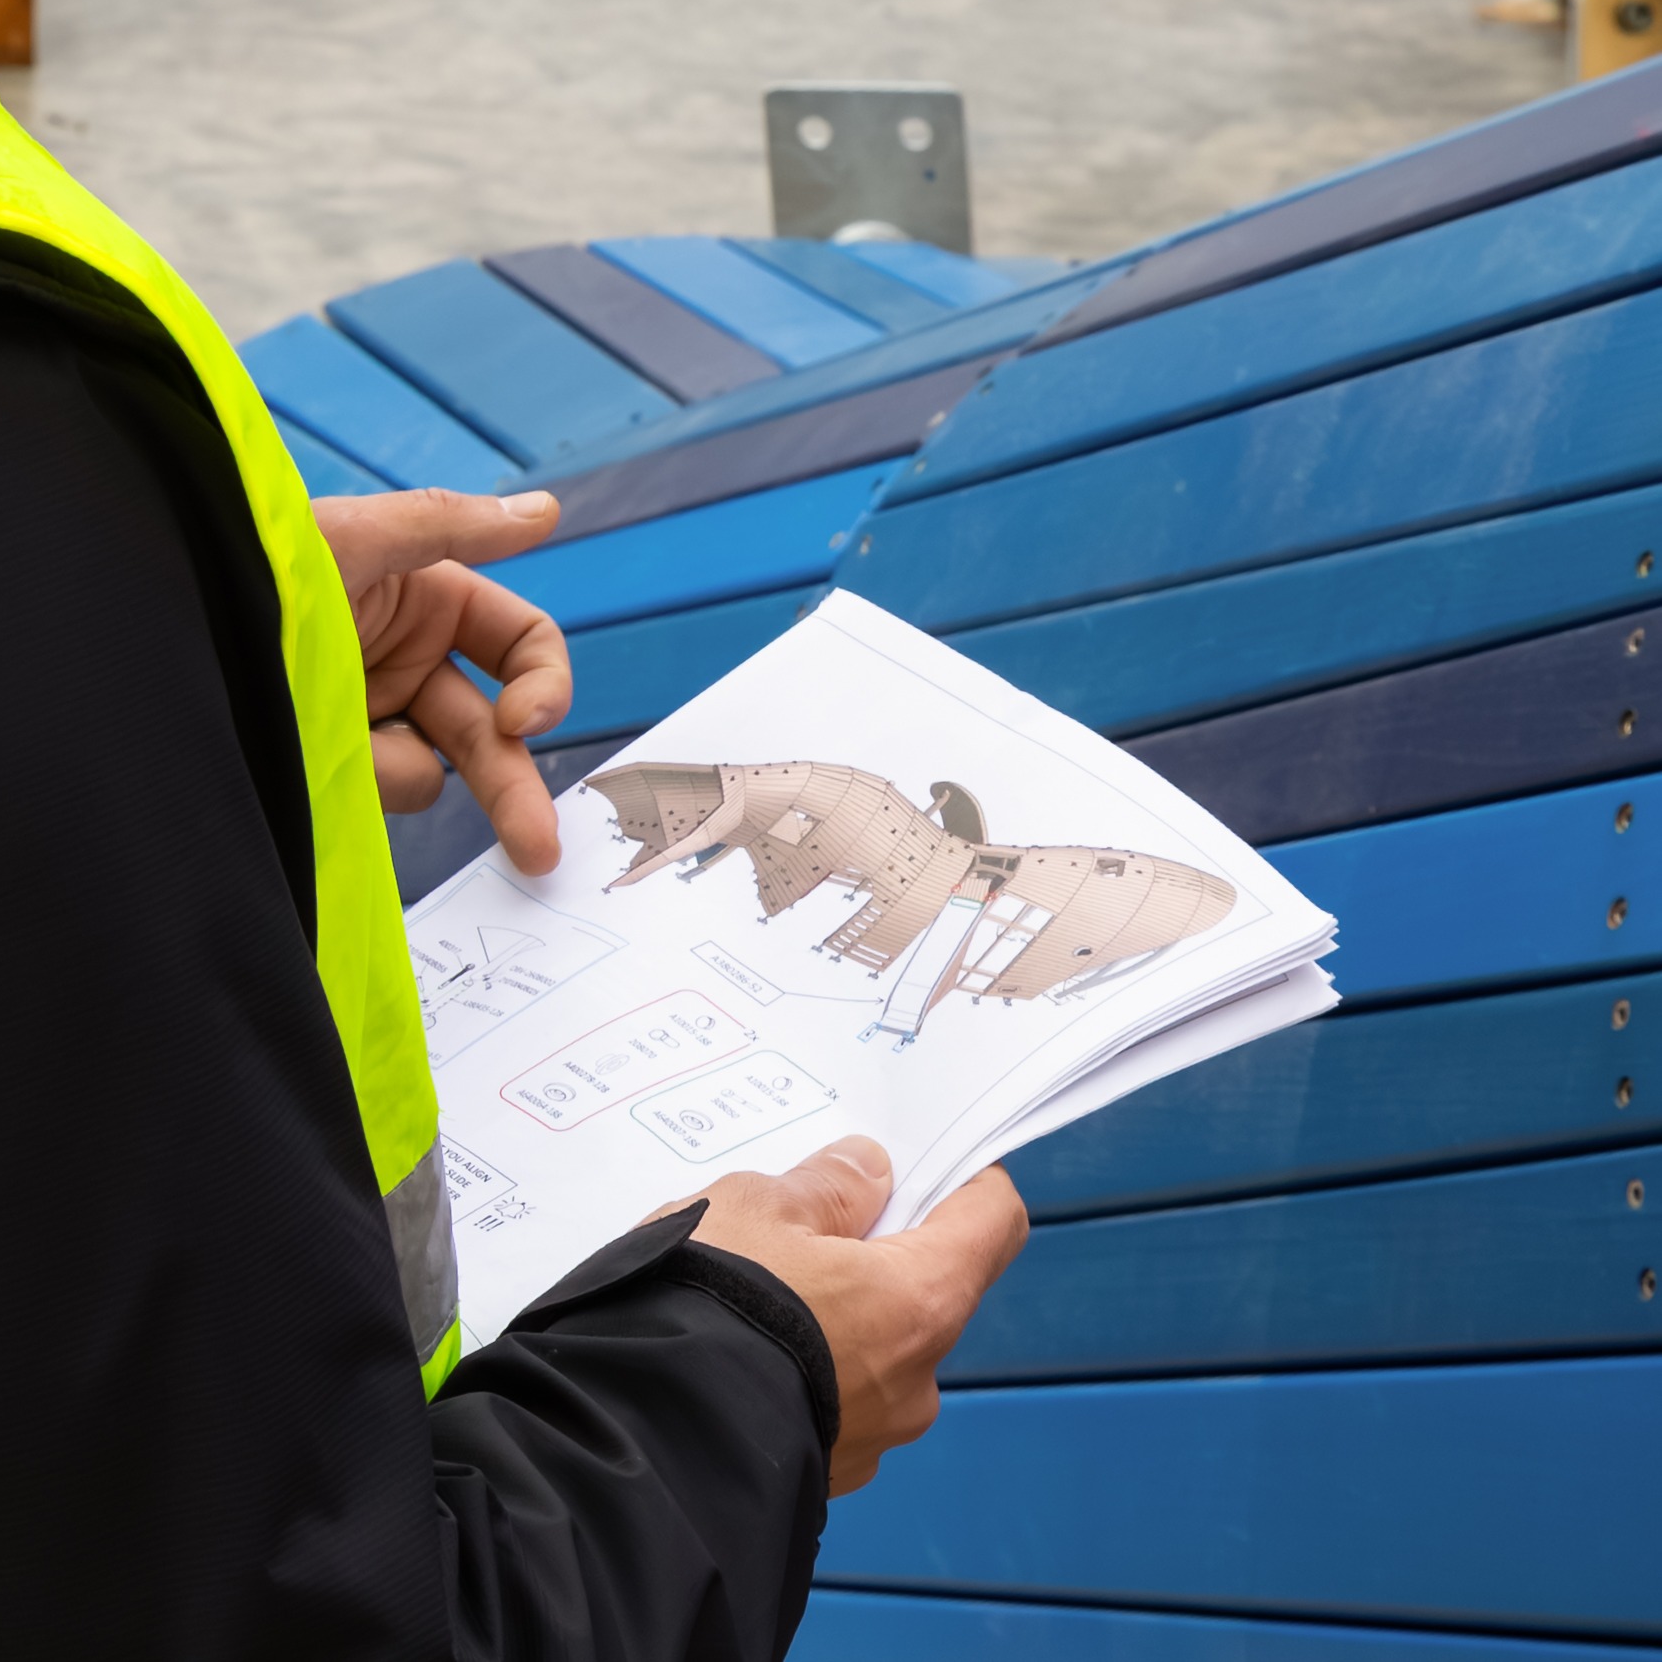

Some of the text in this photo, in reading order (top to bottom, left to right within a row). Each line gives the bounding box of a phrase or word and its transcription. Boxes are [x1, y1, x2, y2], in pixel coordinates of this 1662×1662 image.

[744, 1029, 759, 1042] 2x
[824, 1088, 840, 1101] 3x
[444, 1148, 492, 1182] YOU ALIGN
[446, 1169, 472, 1188] SLIDE
